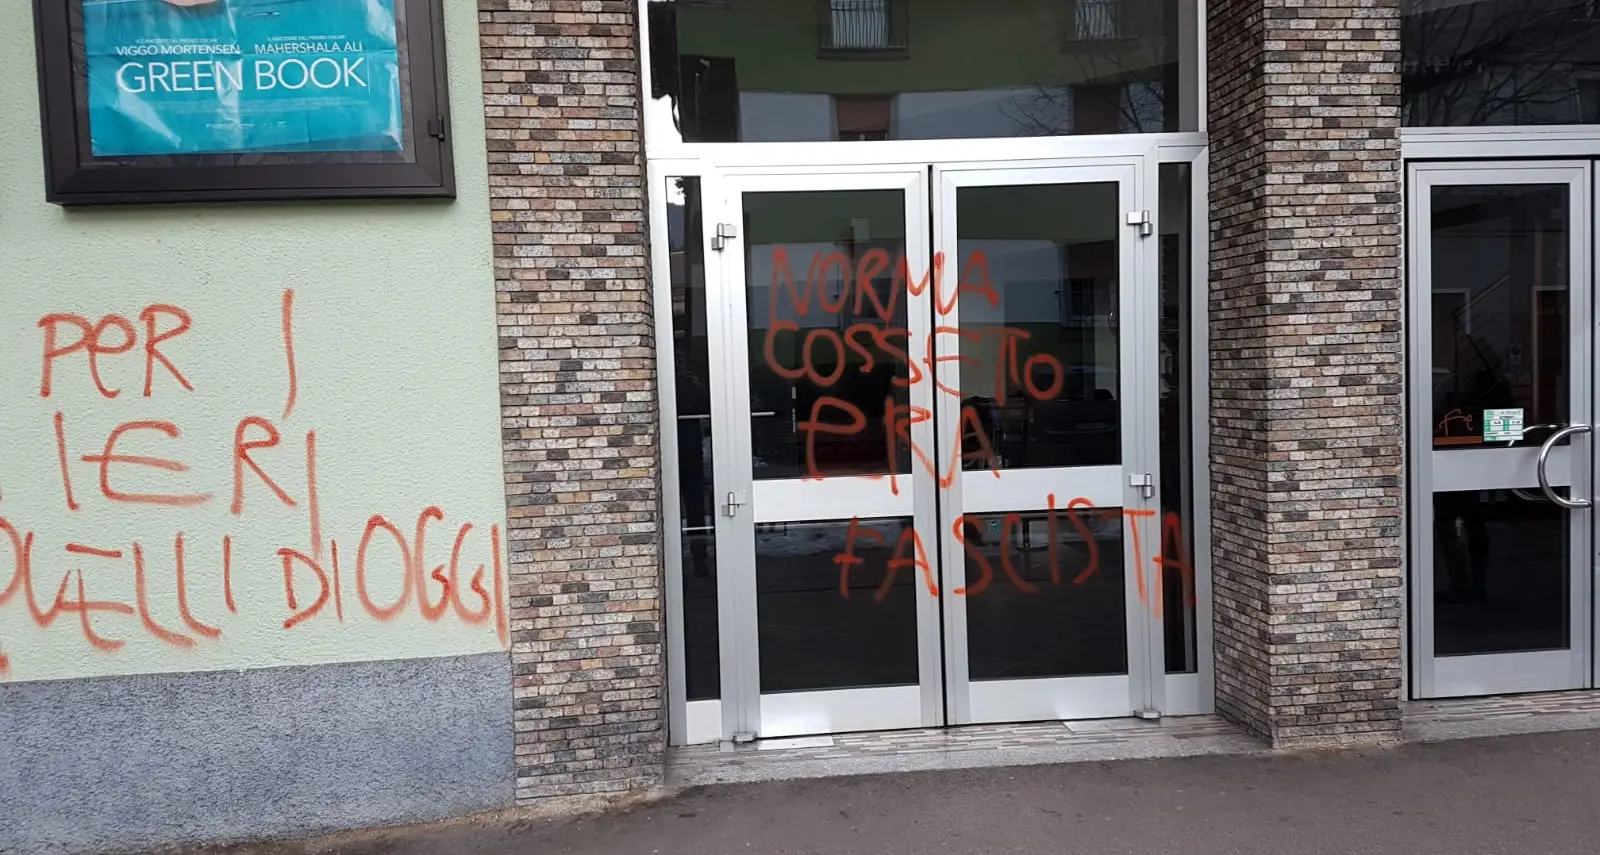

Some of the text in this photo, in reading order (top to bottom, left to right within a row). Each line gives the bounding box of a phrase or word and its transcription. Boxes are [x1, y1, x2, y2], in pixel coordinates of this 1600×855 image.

[115, 43, 241, 57] VIGGO MORTENSEN
[116, 57, 368, 93] GREEN BOOK
[254, 40, 364, 55] MAHERSHALA ALI
[767, 246, 1000, 323] NORMA
[53, 411, 323, 560] IERI
[276, 537, 344, 631] DI
[355, 505, 510, 650] OGGI
[833, 494, 1196, 618] FASCISTA
